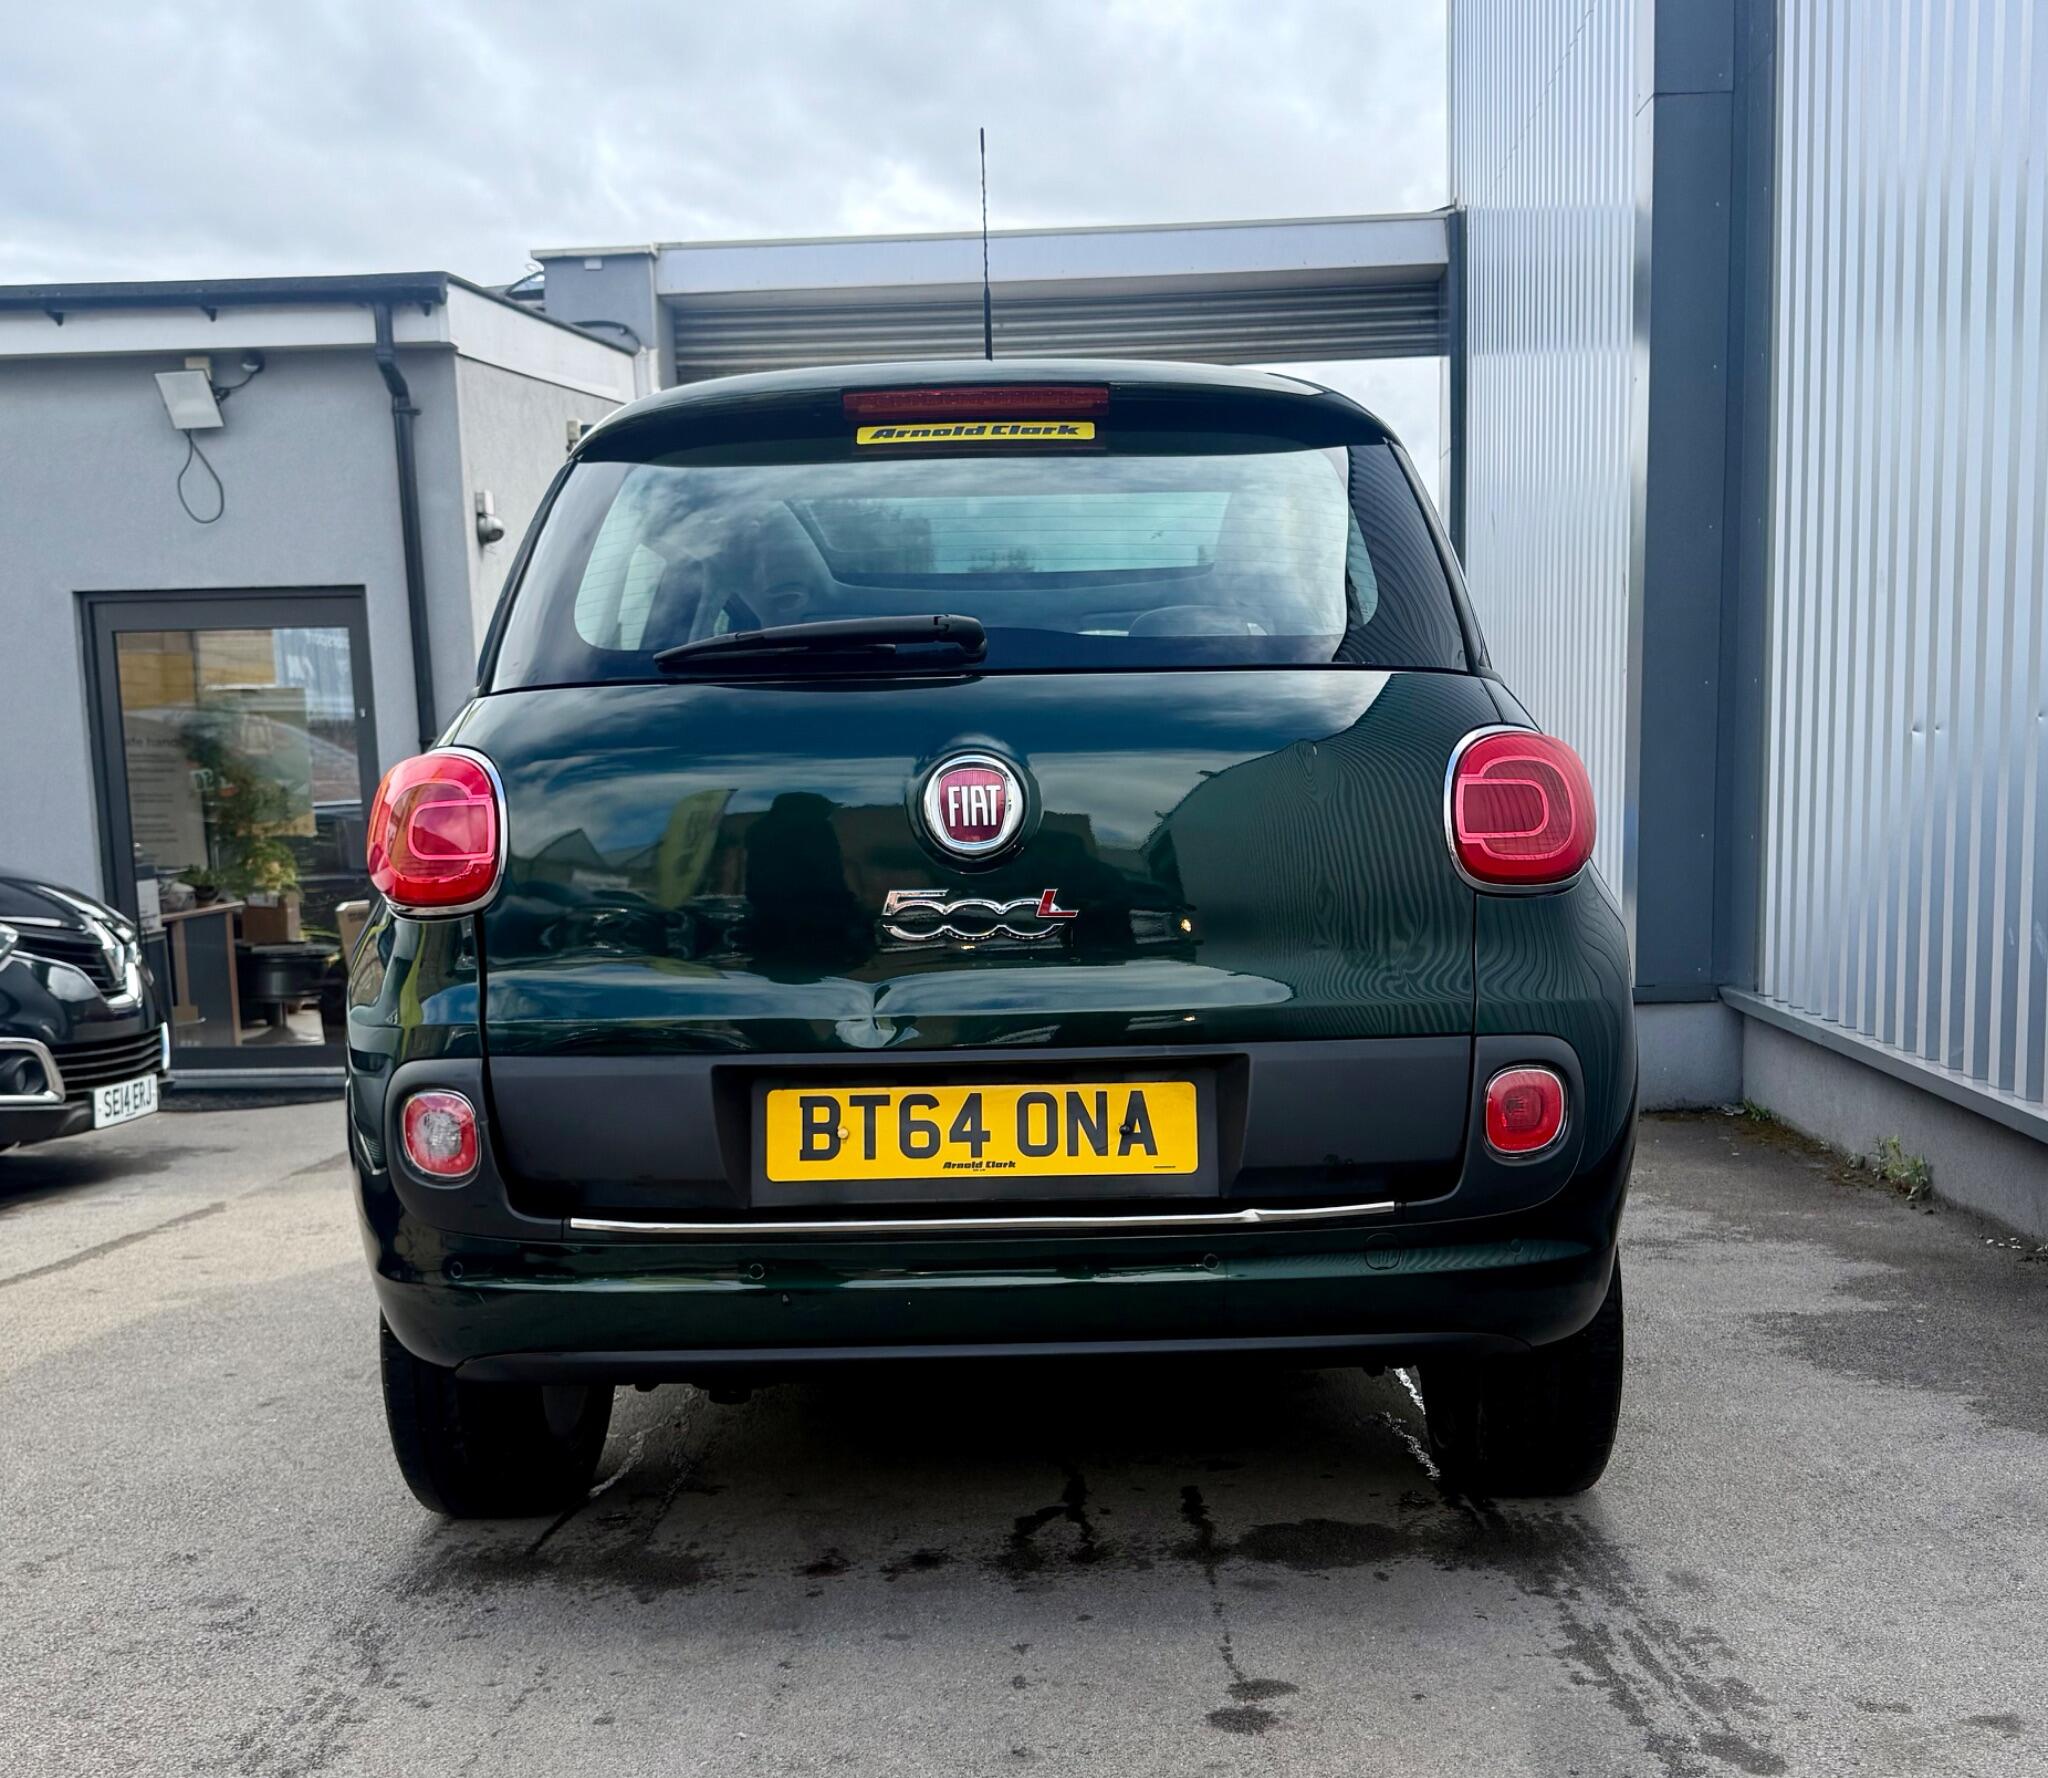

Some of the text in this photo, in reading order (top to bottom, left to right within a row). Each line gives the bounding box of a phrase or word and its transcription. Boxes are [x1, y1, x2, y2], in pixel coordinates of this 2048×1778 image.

[870, 424, 1080, 440] Arnold Clark
[947, 784, 1002, 828] FIAT
[103, 1078, 152, 1118] SE14 ERJ
[799, 1090, 1159, 1161] BT64 ONA
[942, 1160, 1016, 1169] Arnold Clark
